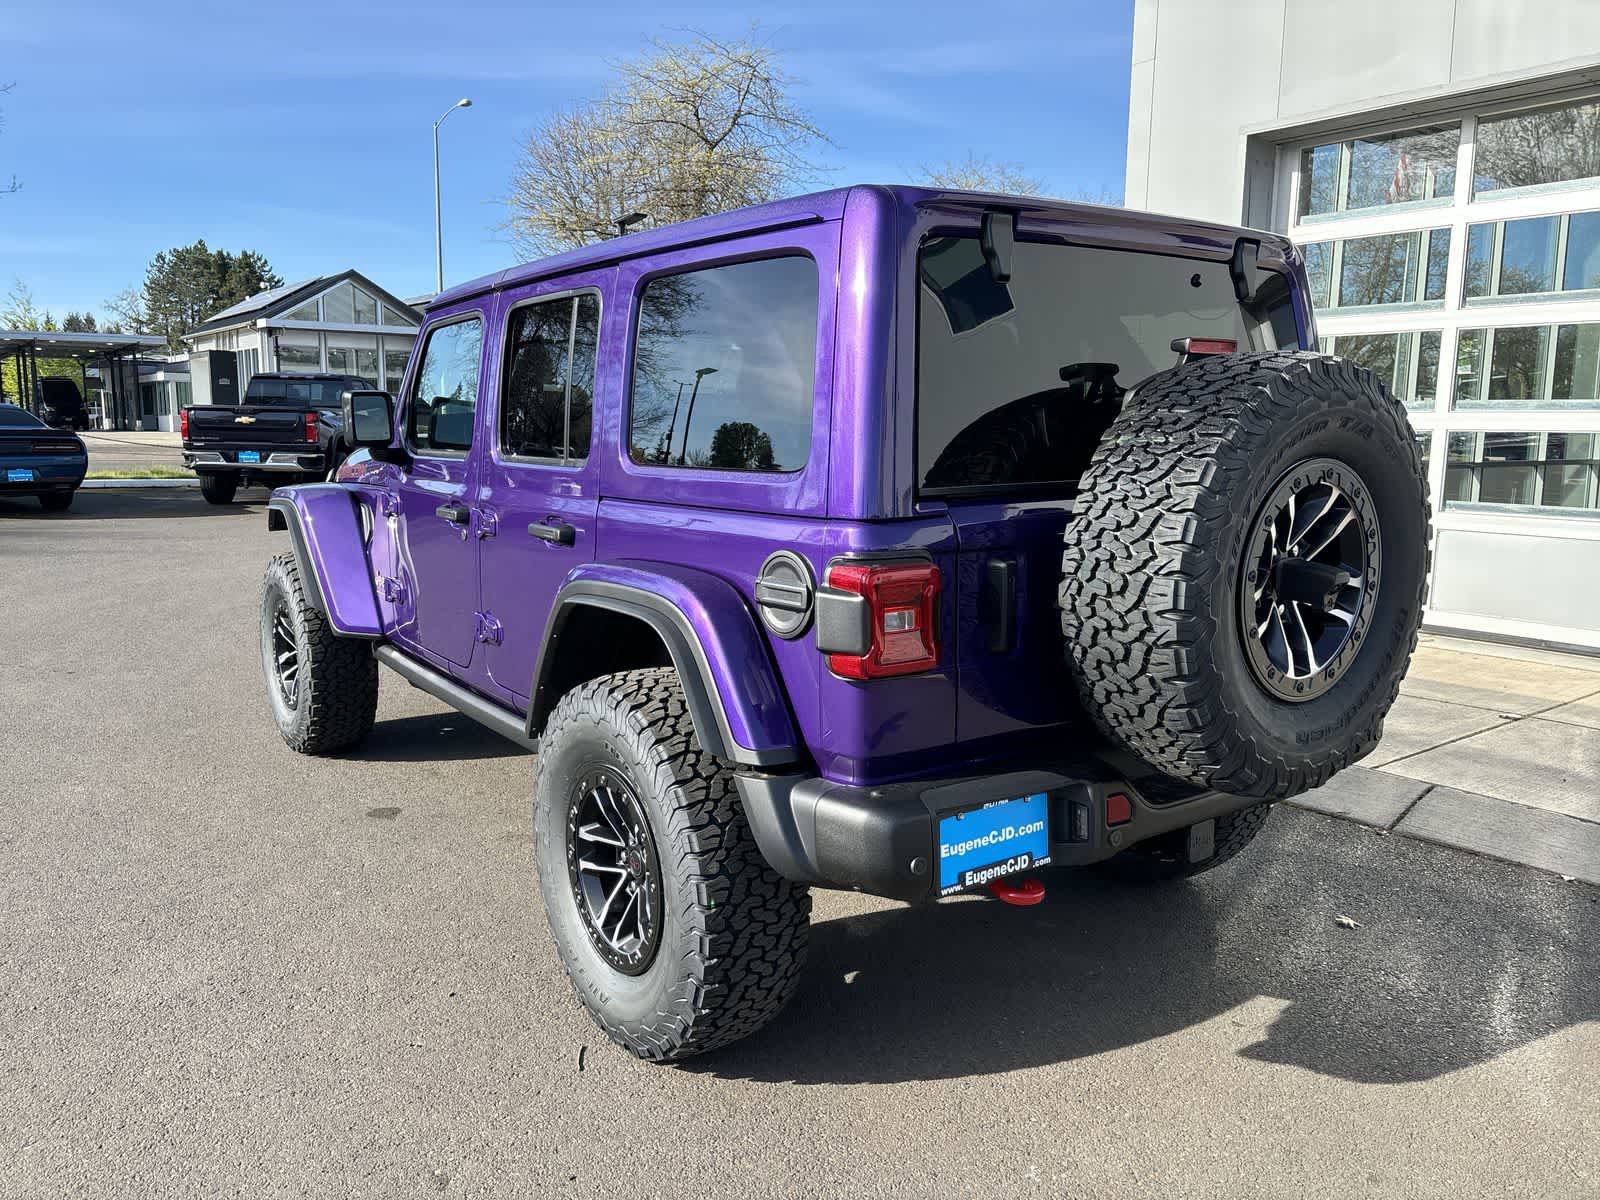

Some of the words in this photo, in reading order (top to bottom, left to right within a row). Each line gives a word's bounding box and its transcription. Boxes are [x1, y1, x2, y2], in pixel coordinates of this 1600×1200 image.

[940, 820, 1044, 858] EugeneCJD.com
[941, 883, 964, 896] www.
[965, 855, 1029, 886] EugeneCJD
[1032, 856, 1051, 868] .com
